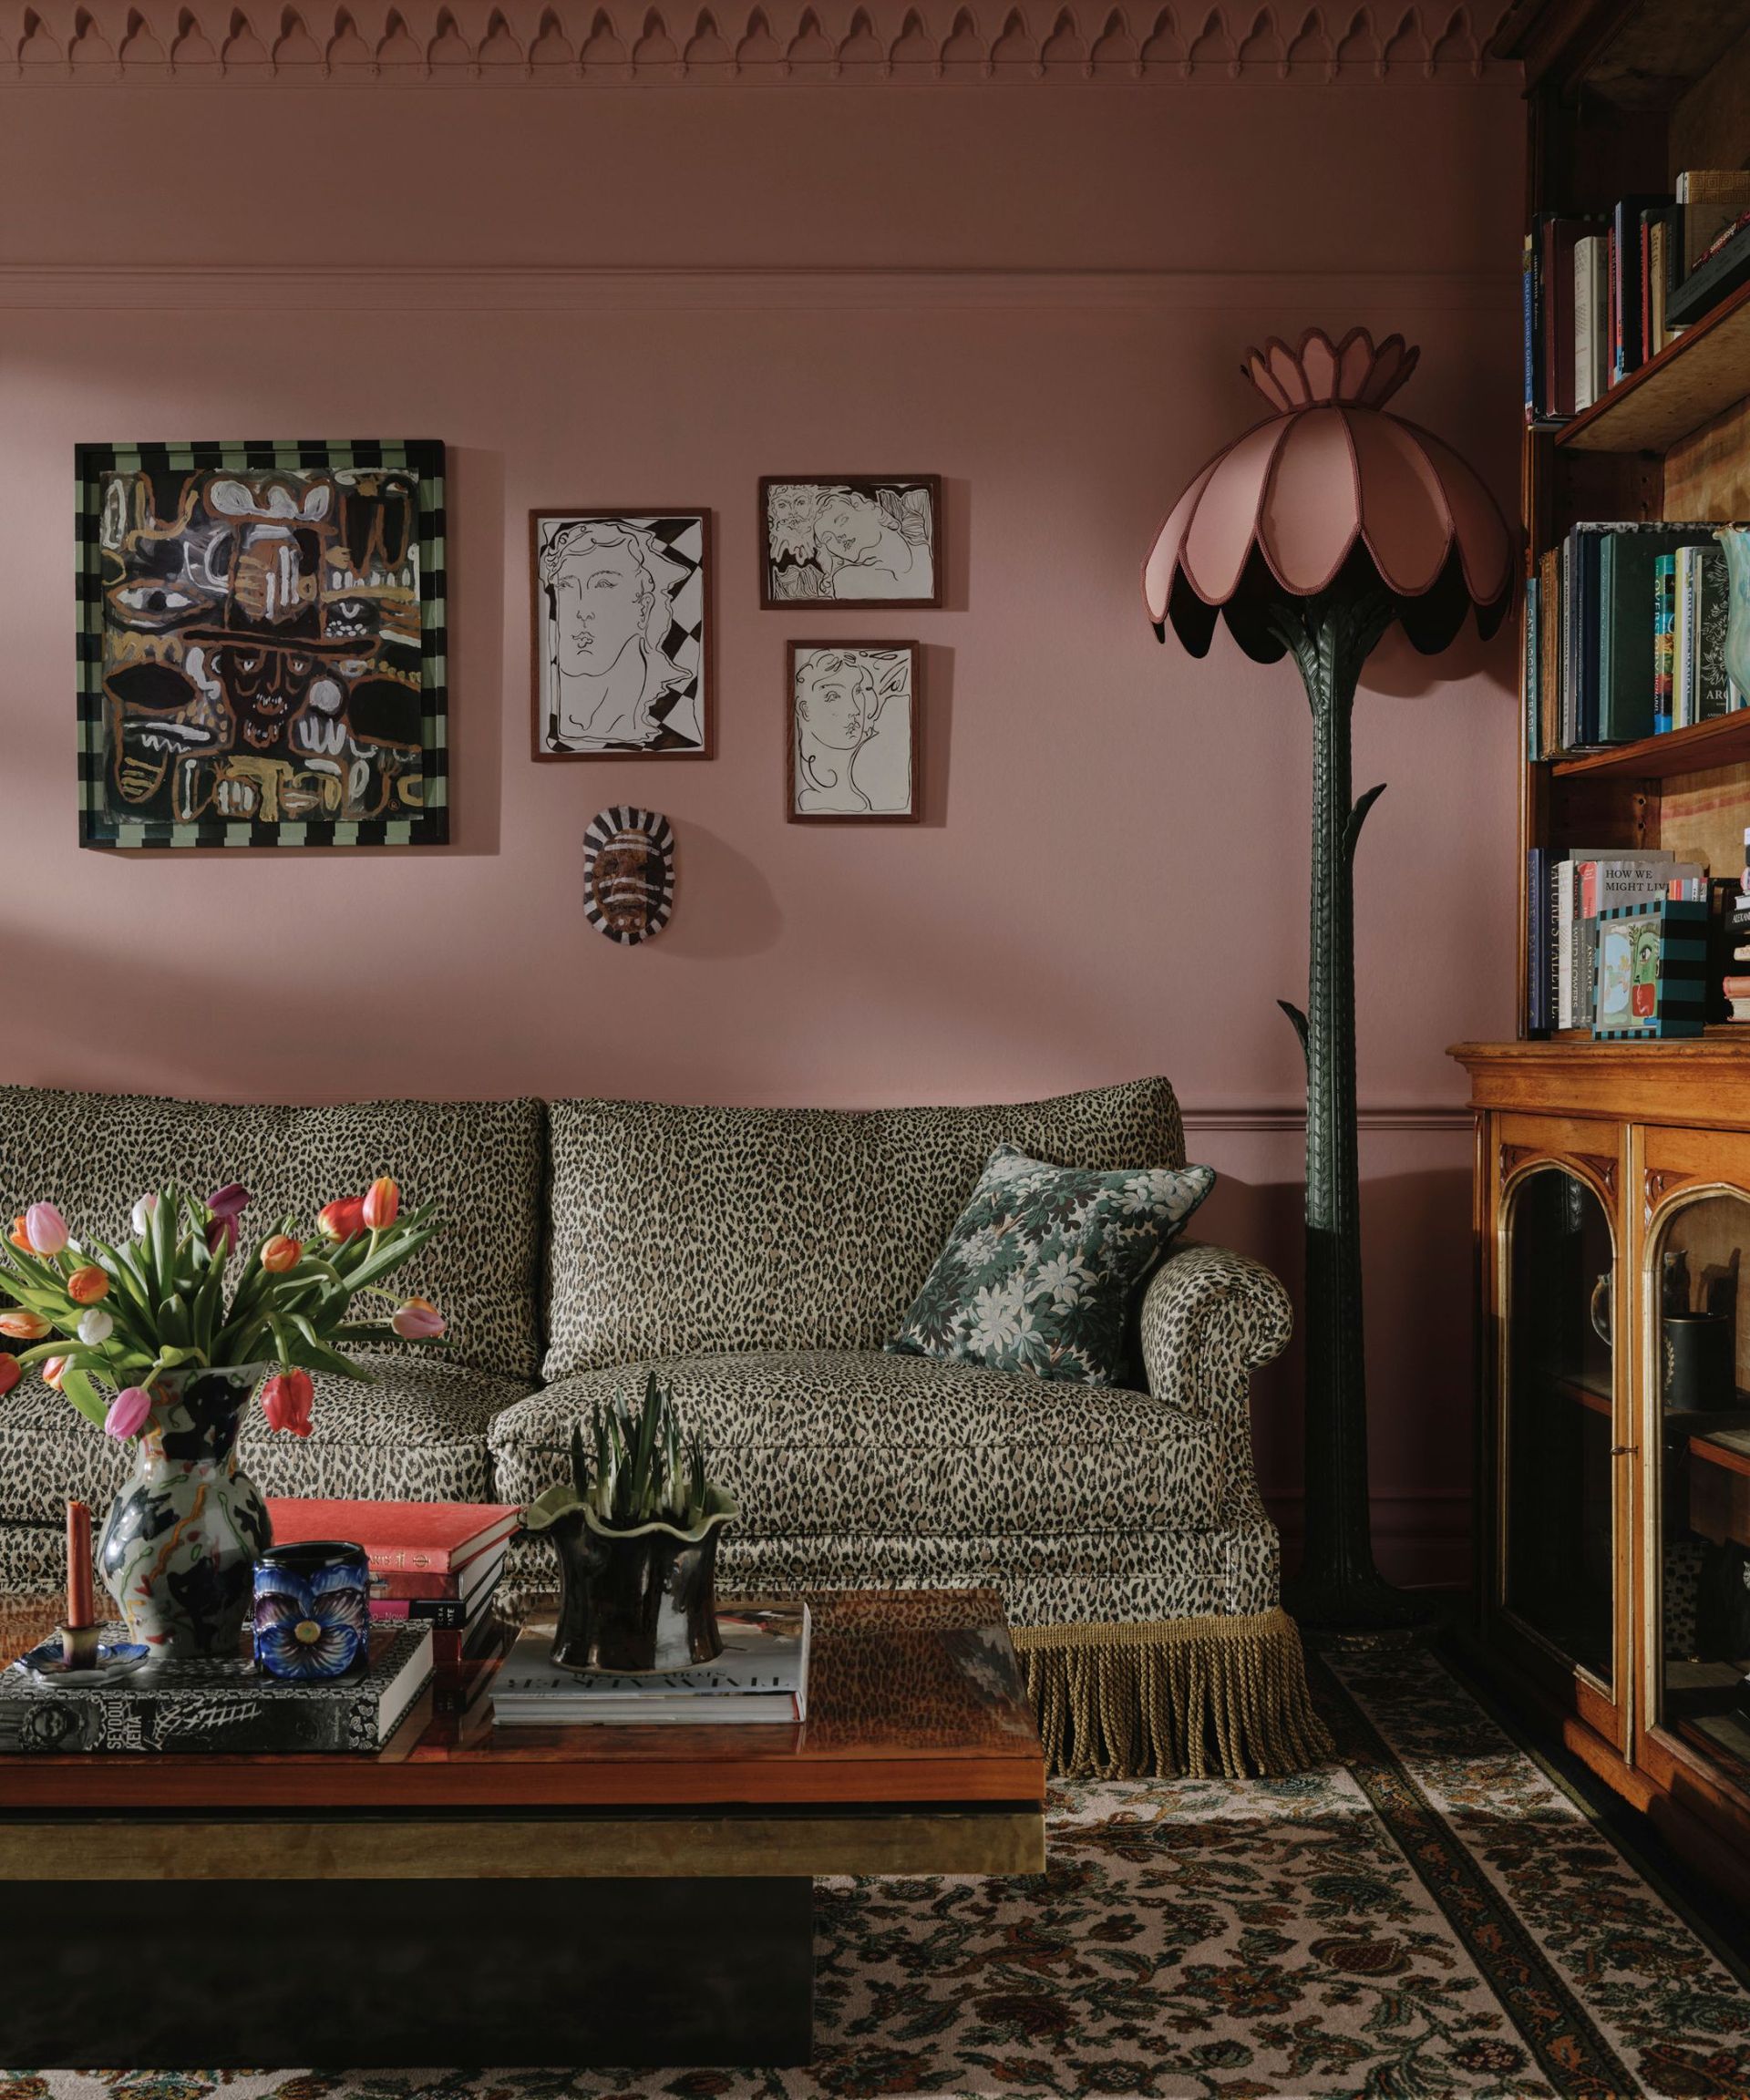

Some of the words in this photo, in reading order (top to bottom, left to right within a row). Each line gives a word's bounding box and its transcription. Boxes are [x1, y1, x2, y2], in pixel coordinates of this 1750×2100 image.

[1605, 870, 1632, 879] HOW
[1635, 870, 1653, 880] WE
[1605, 882, 1644, 891] MIGHT
[1528, 860, 1537, 926] NATURE'S
[1529, 932, 1538, 1000] PALETTE
[507, 1678, 696, 1689] WALKER
[107, 1700, 123, 1750] SEYDOU
